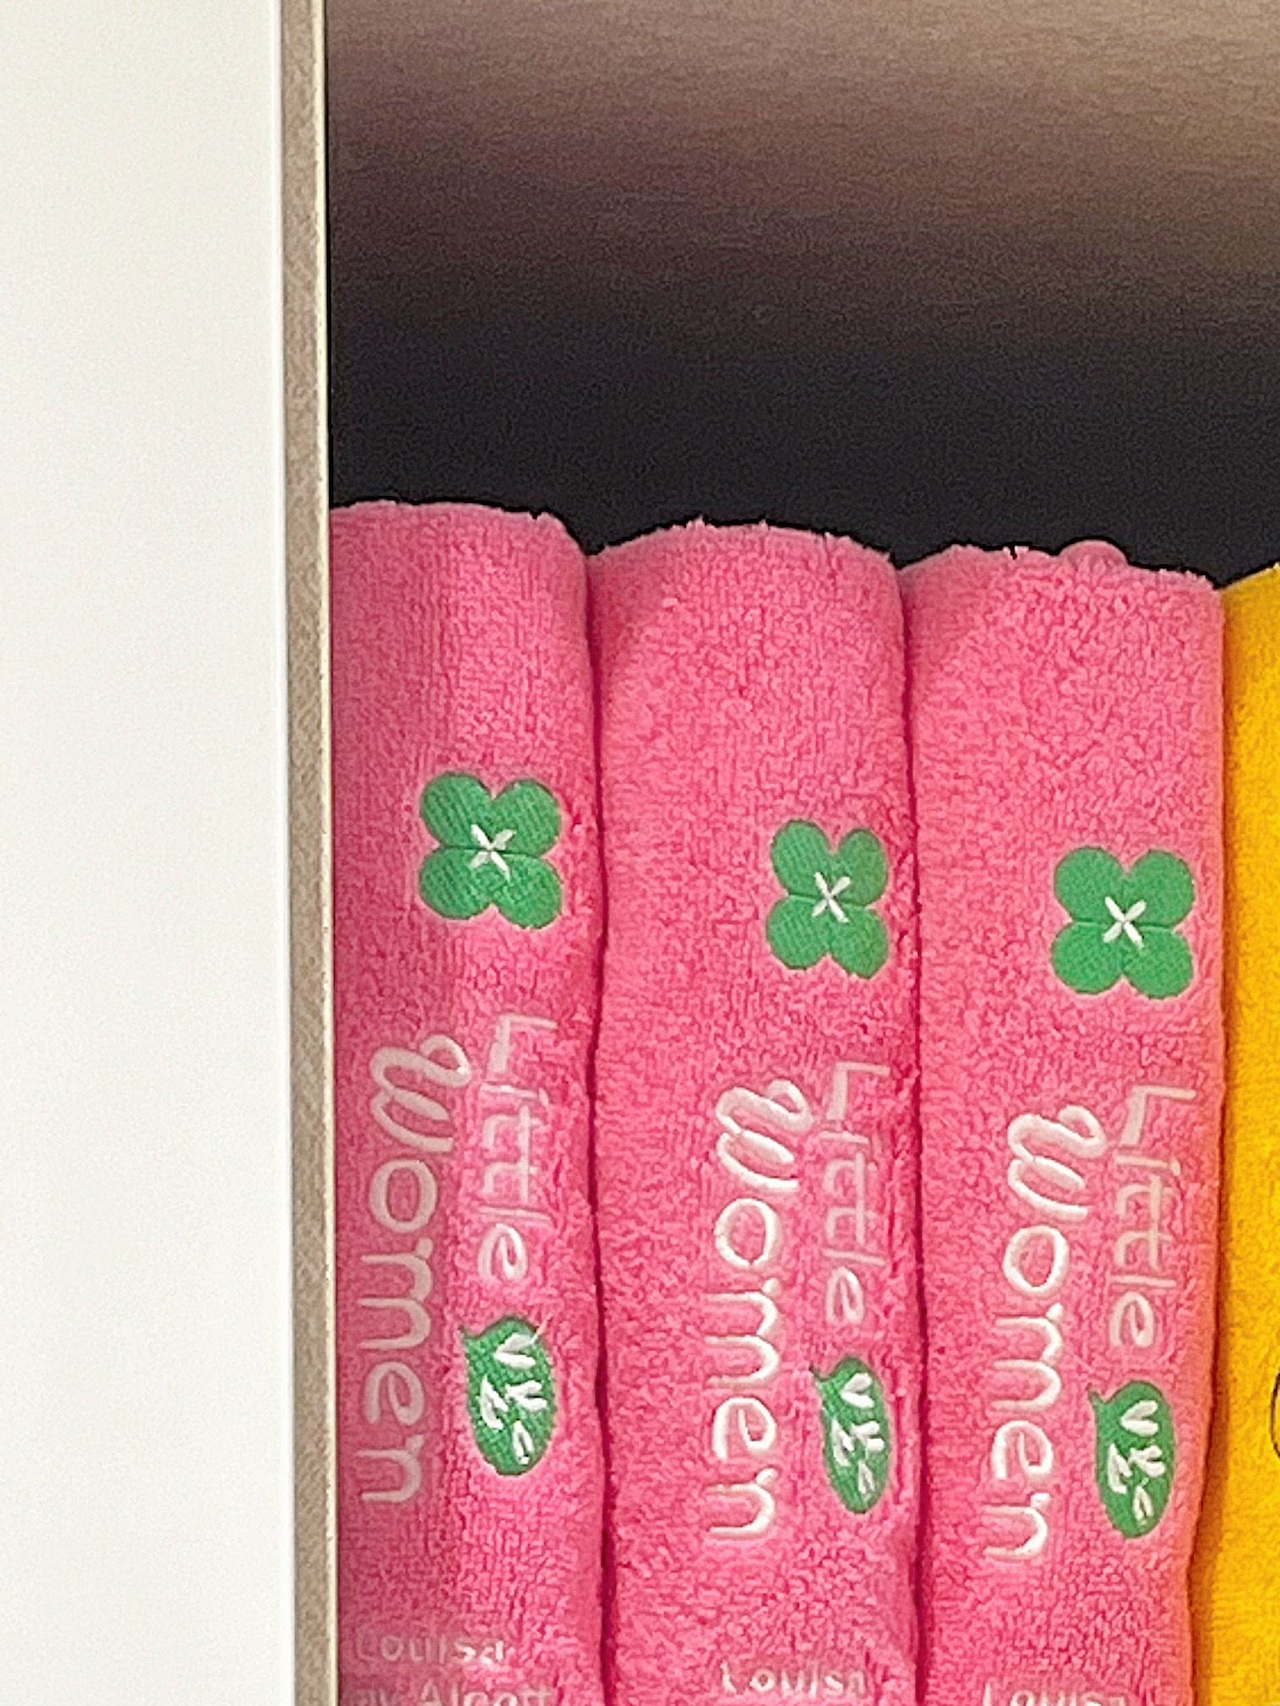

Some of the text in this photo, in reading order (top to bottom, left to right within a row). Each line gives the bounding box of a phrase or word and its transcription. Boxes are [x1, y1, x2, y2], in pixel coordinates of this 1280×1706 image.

[361, 1034, 471, 1502] Women
[477, 1013, 557, 1281] Little
[706, 1078, 813, 1540] Women
[817, 1061, 891, 1325] Little
[1111, 1084, 1197, 1348] Little
[983, 1105, 1107, 1558] Women
